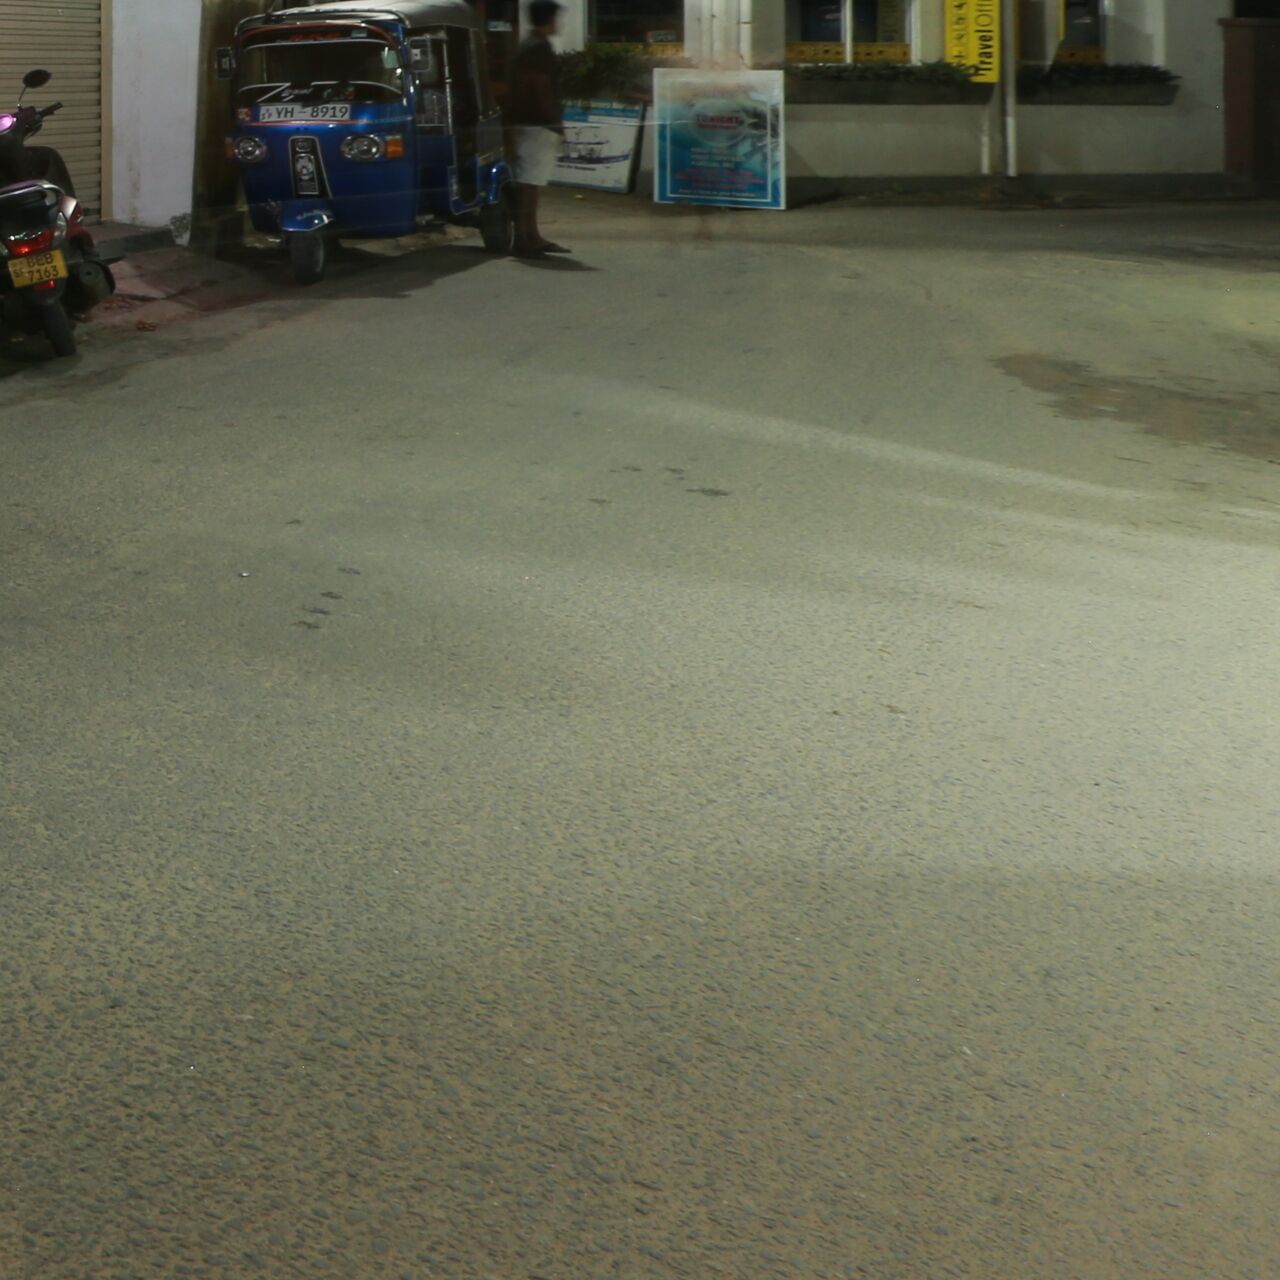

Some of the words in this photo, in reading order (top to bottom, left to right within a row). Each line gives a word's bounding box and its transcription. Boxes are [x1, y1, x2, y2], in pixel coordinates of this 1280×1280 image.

[276, 107, 294, 119] YH
[310, 106, 349, 119] 8919
[28, 265, 59, 282] 7163
